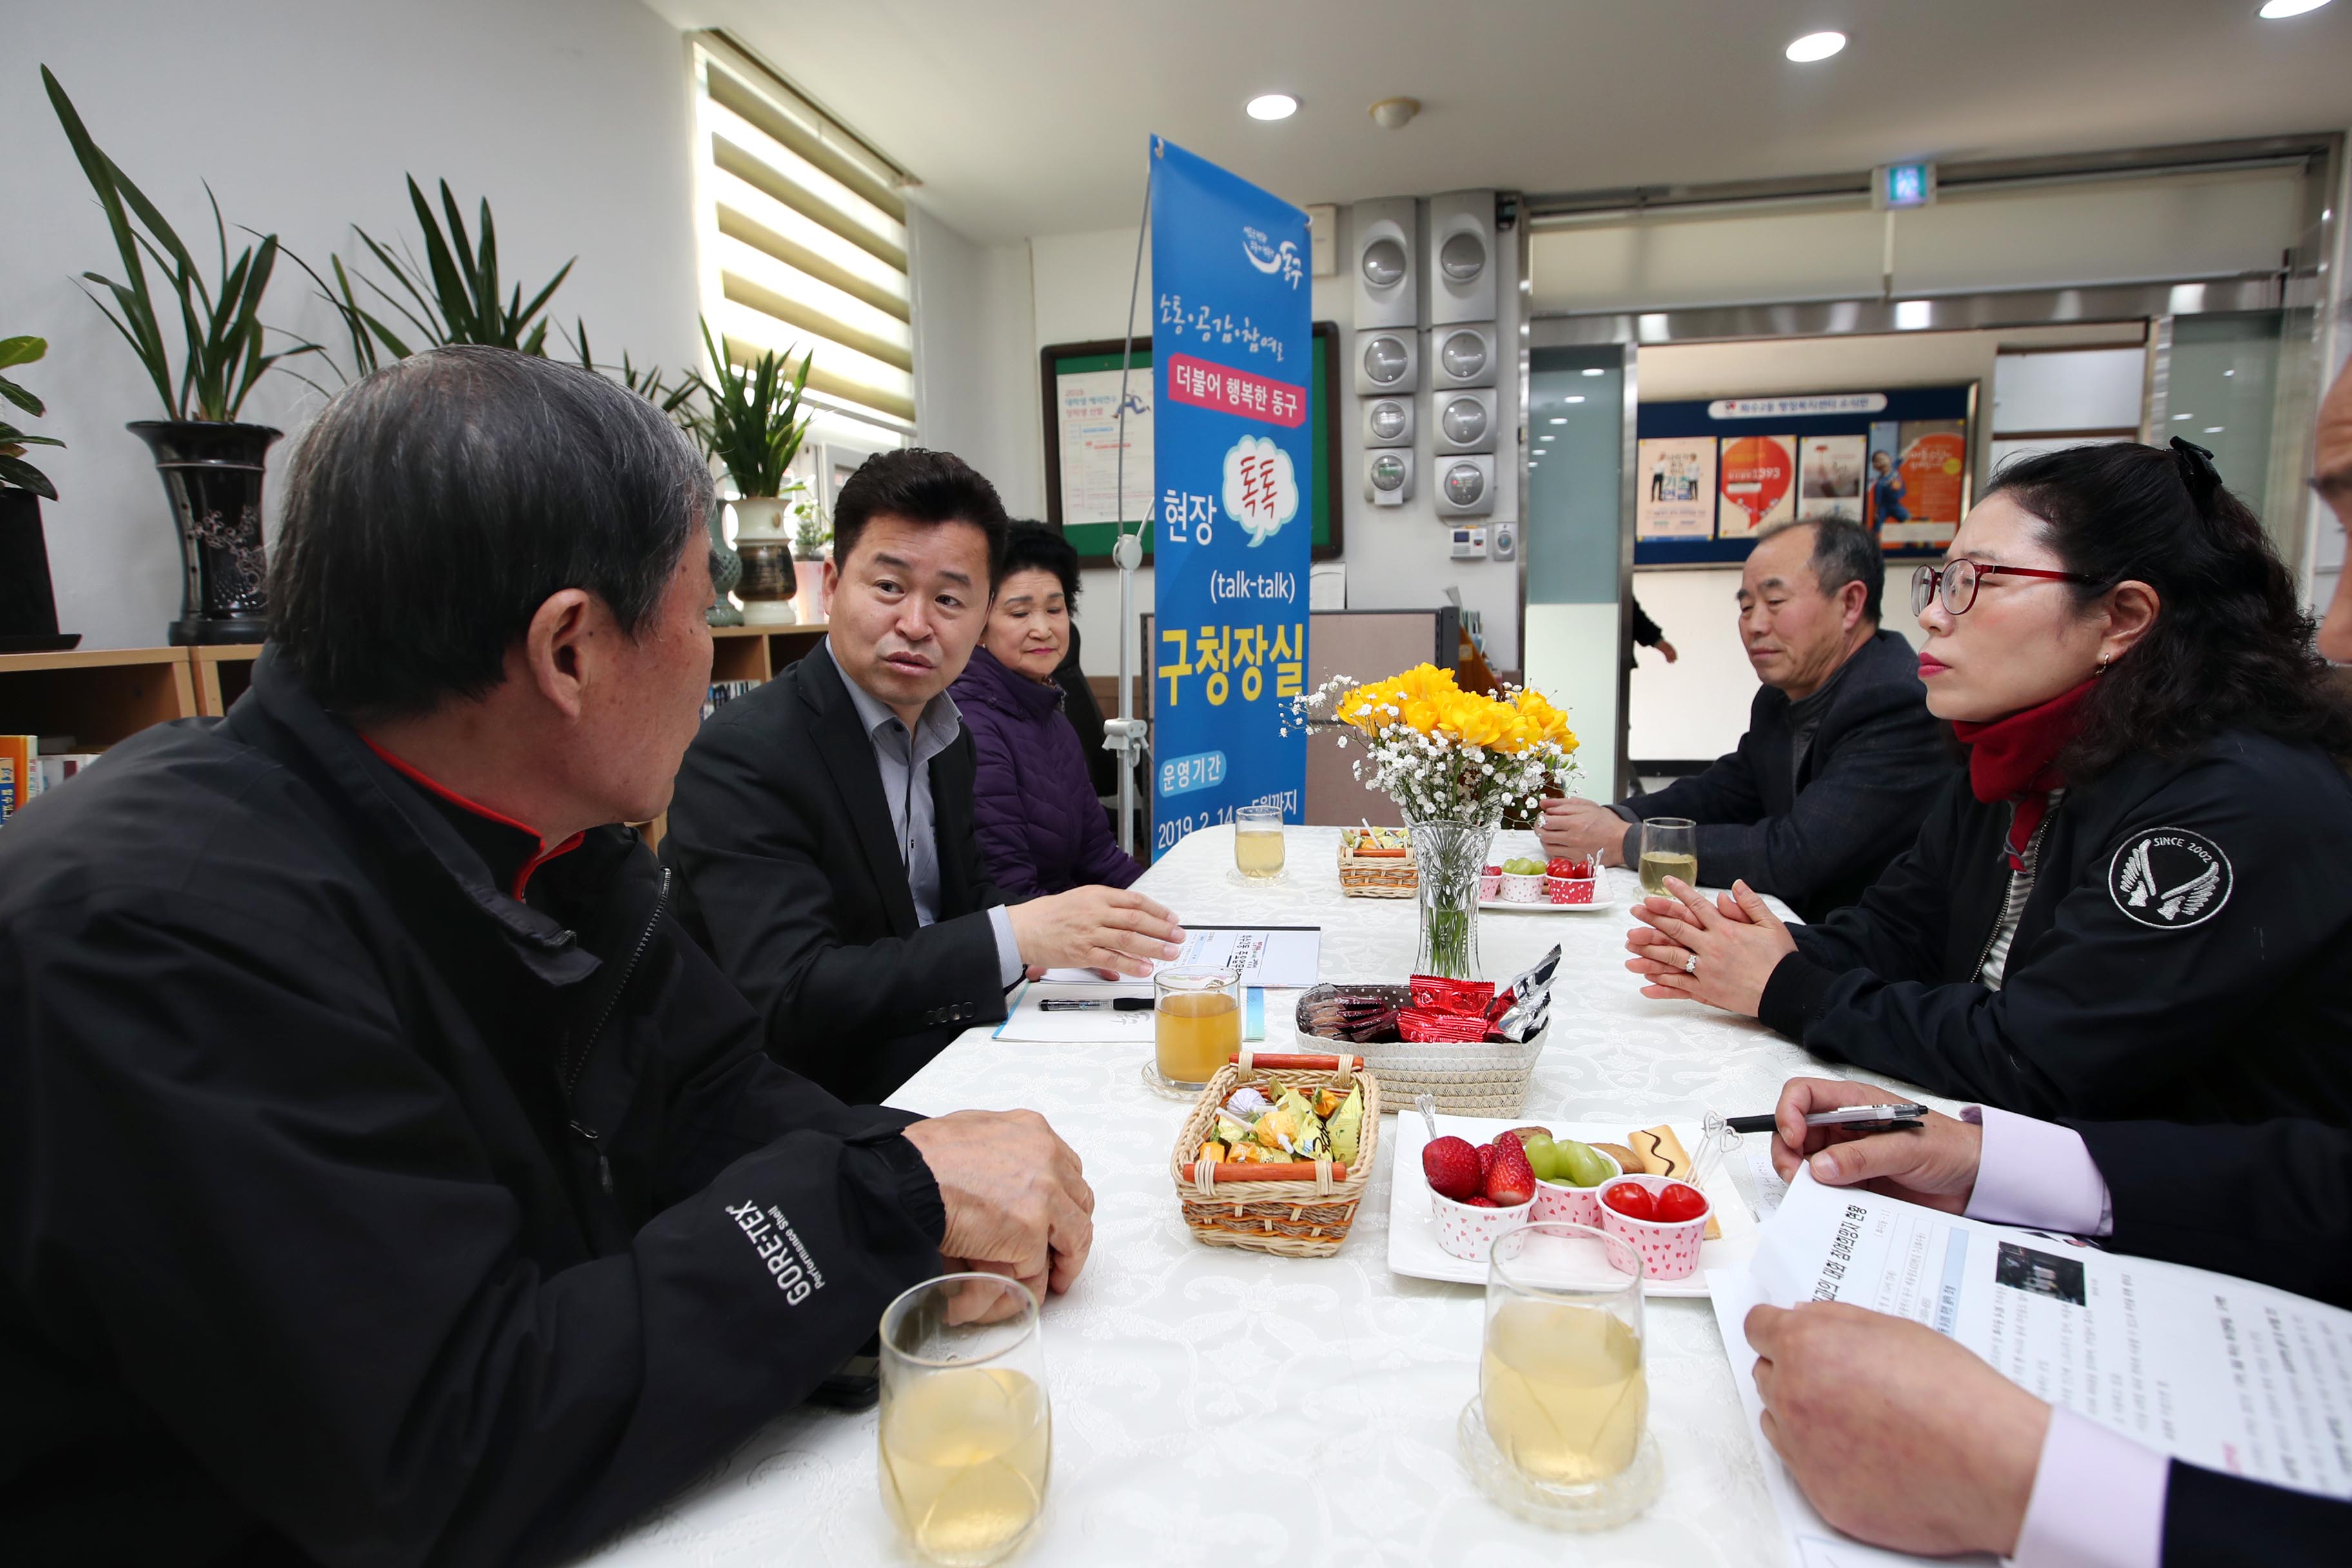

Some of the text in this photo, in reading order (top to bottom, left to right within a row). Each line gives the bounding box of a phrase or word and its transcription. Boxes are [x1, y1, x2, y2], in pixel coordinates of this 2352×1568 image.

[1176, 364, 1297, 418] 더불어 행복한 동구
[1240, 456, 1277, 519] 톡톡
[1163, 489, 1217, 545] 현장
[1210, 569, 1296, 604] (talk-talk)
[1158, 623, 1303, 707] 구청장실
[1163, 754, 1220, 792] 운영기간
[2153, 837, 2213, 863] SINCE 2002
[1845, 1204, 1867, 1222] 현황
[767, 1205, 825, 1289] Performance Shell
[1830, 1220, 1862, 1262] 참여희망자
[1823, 1259, 1847, 1280] 대화
